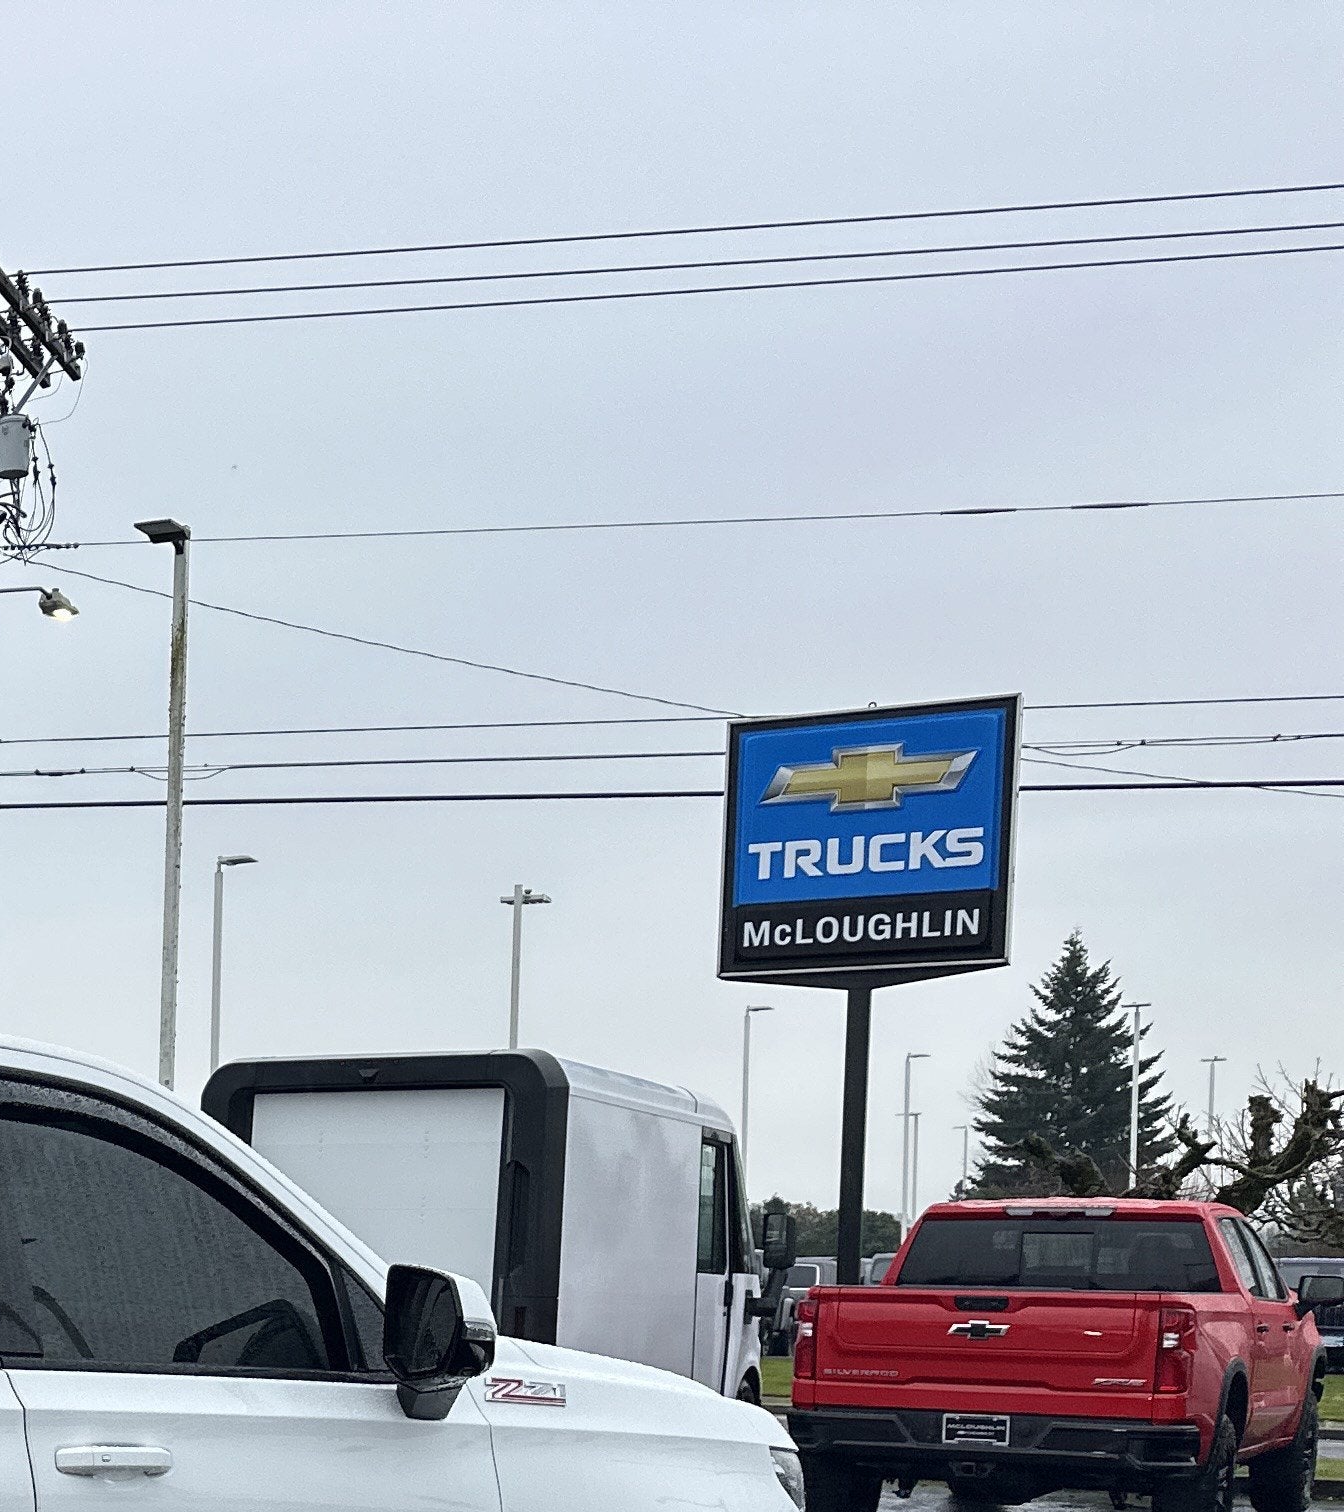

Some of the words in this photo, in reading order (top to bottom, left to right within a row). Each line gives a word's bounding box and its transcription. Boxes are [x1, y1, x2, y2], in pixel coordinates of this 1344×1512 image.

[748, 826, 985, 880] TRUCKS
[742, 908, 981, 948] McLOUGHLIN
[823, 1368, 899, 1377] SILVERADO
[484, 1377, 567, 1407] Z71
